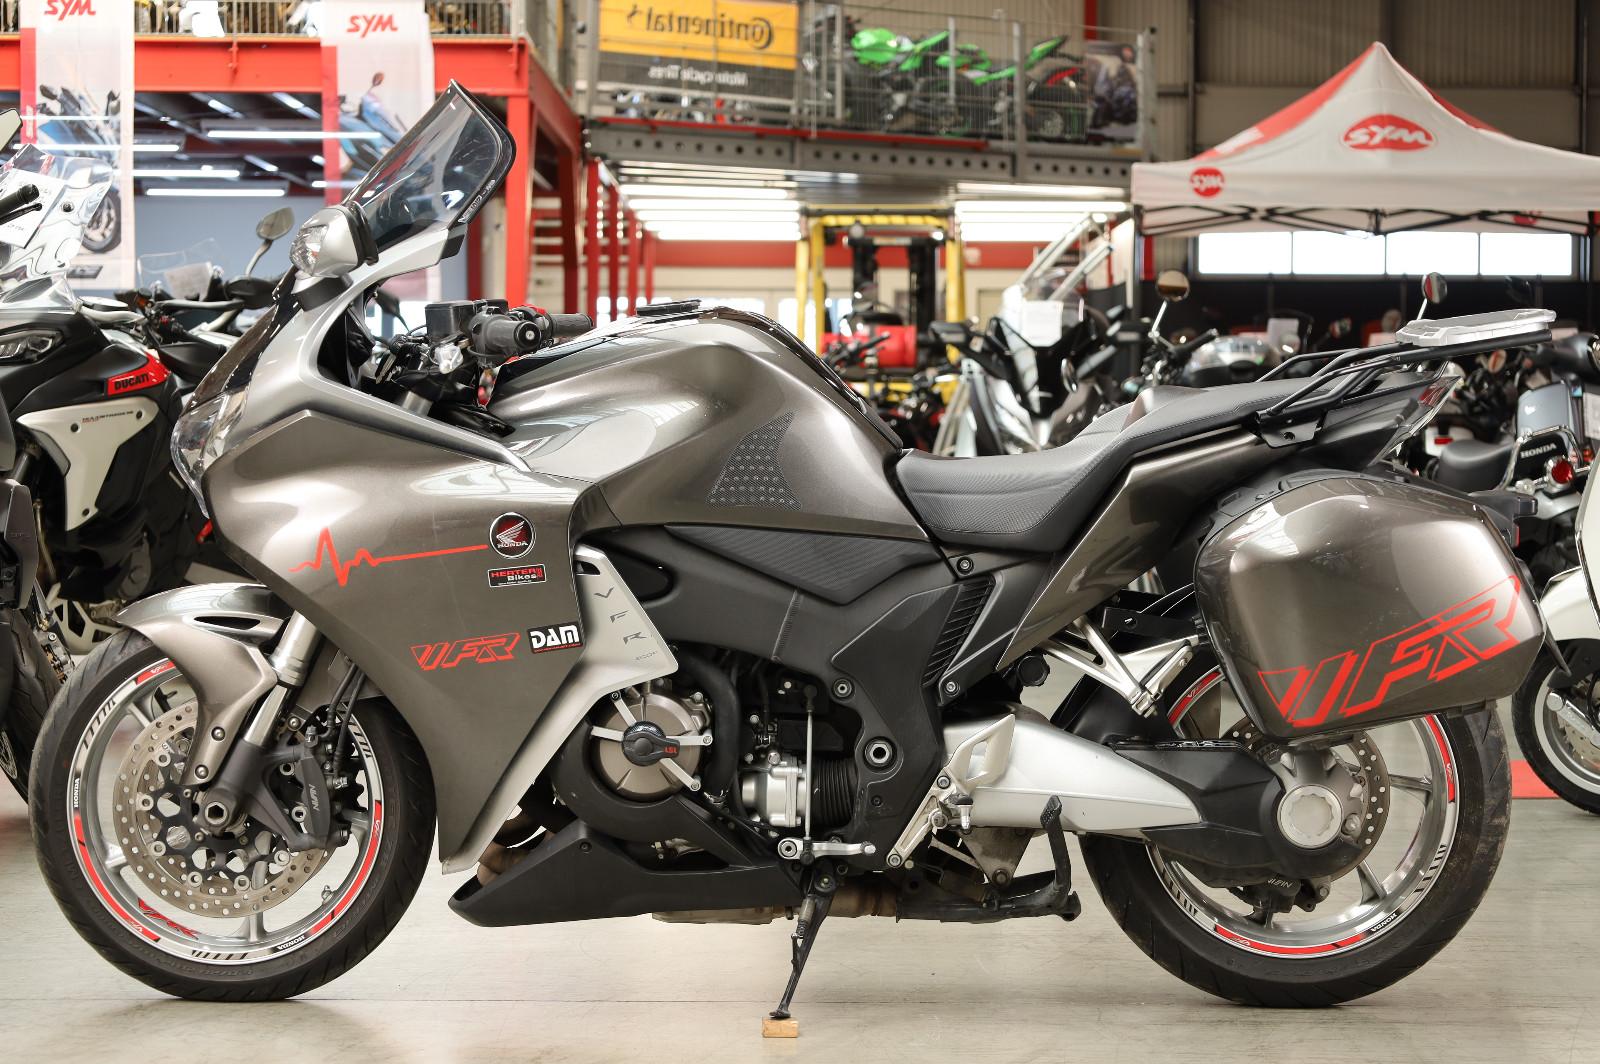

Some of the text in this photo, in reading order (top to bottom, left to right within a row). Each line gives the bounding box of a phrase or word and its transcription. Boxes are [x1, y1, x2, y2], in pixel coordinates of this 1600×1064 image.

[44, 0, 96, 21] SYM
[347, 14, 398, 38] SYM
[1348, 125, 1434, 146] SYM
[1190, 174, 1224, 192] SYM
[114, 373, 149, 390] DUCATI
[1520, 443, 1557, 459] HONDA
[497, 541, 529, 549] HONDA
[529, 624, 580, 649] DAM
[409, 632, 521, 670] VFR
[1257, 575, 1521, 728] VFR
[1370, 912, 1398, 932] HONDA
[276, 935, 306, 951] HONDA
